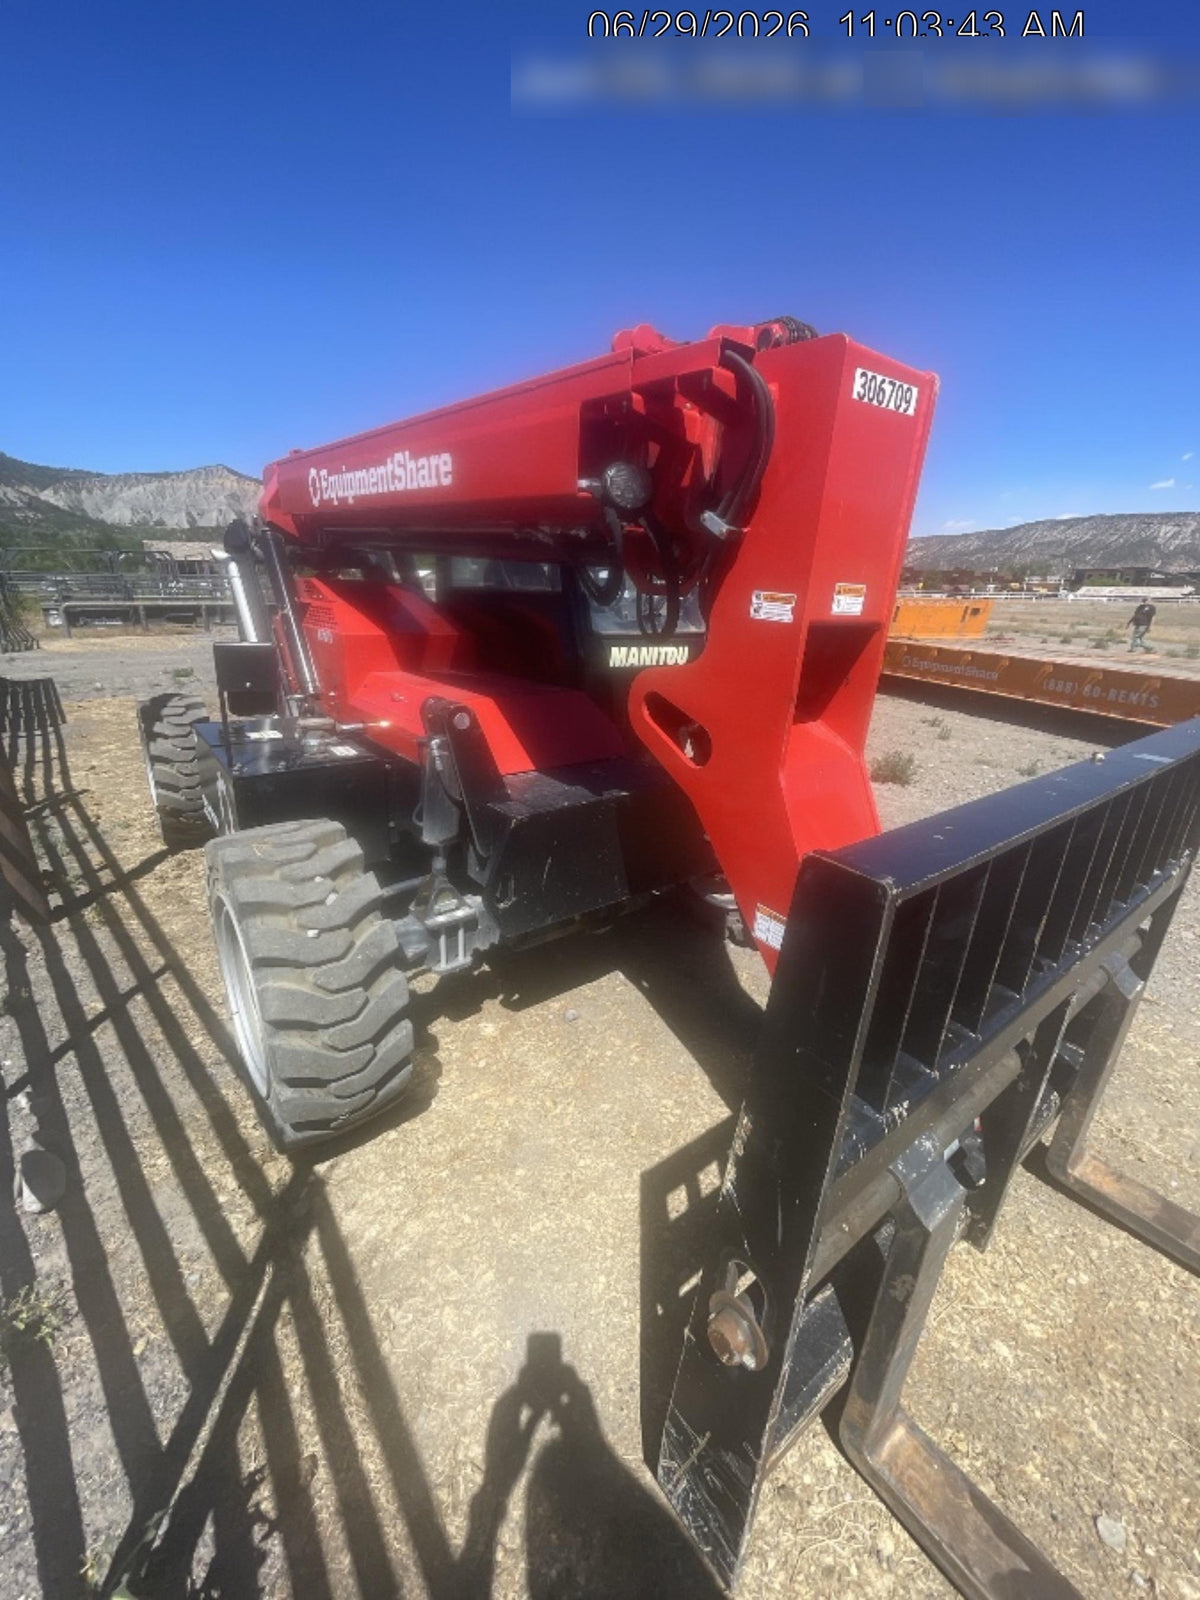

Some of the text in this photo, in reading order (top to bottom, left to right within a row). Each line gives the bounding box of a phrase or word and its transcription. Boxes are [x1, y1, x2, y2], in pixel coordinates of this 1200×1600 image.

[856, 371, 913, 413] 306709
[319, 451, 453, 505] EquipmentShare
[609, 646, 689, 667] MANITOU
